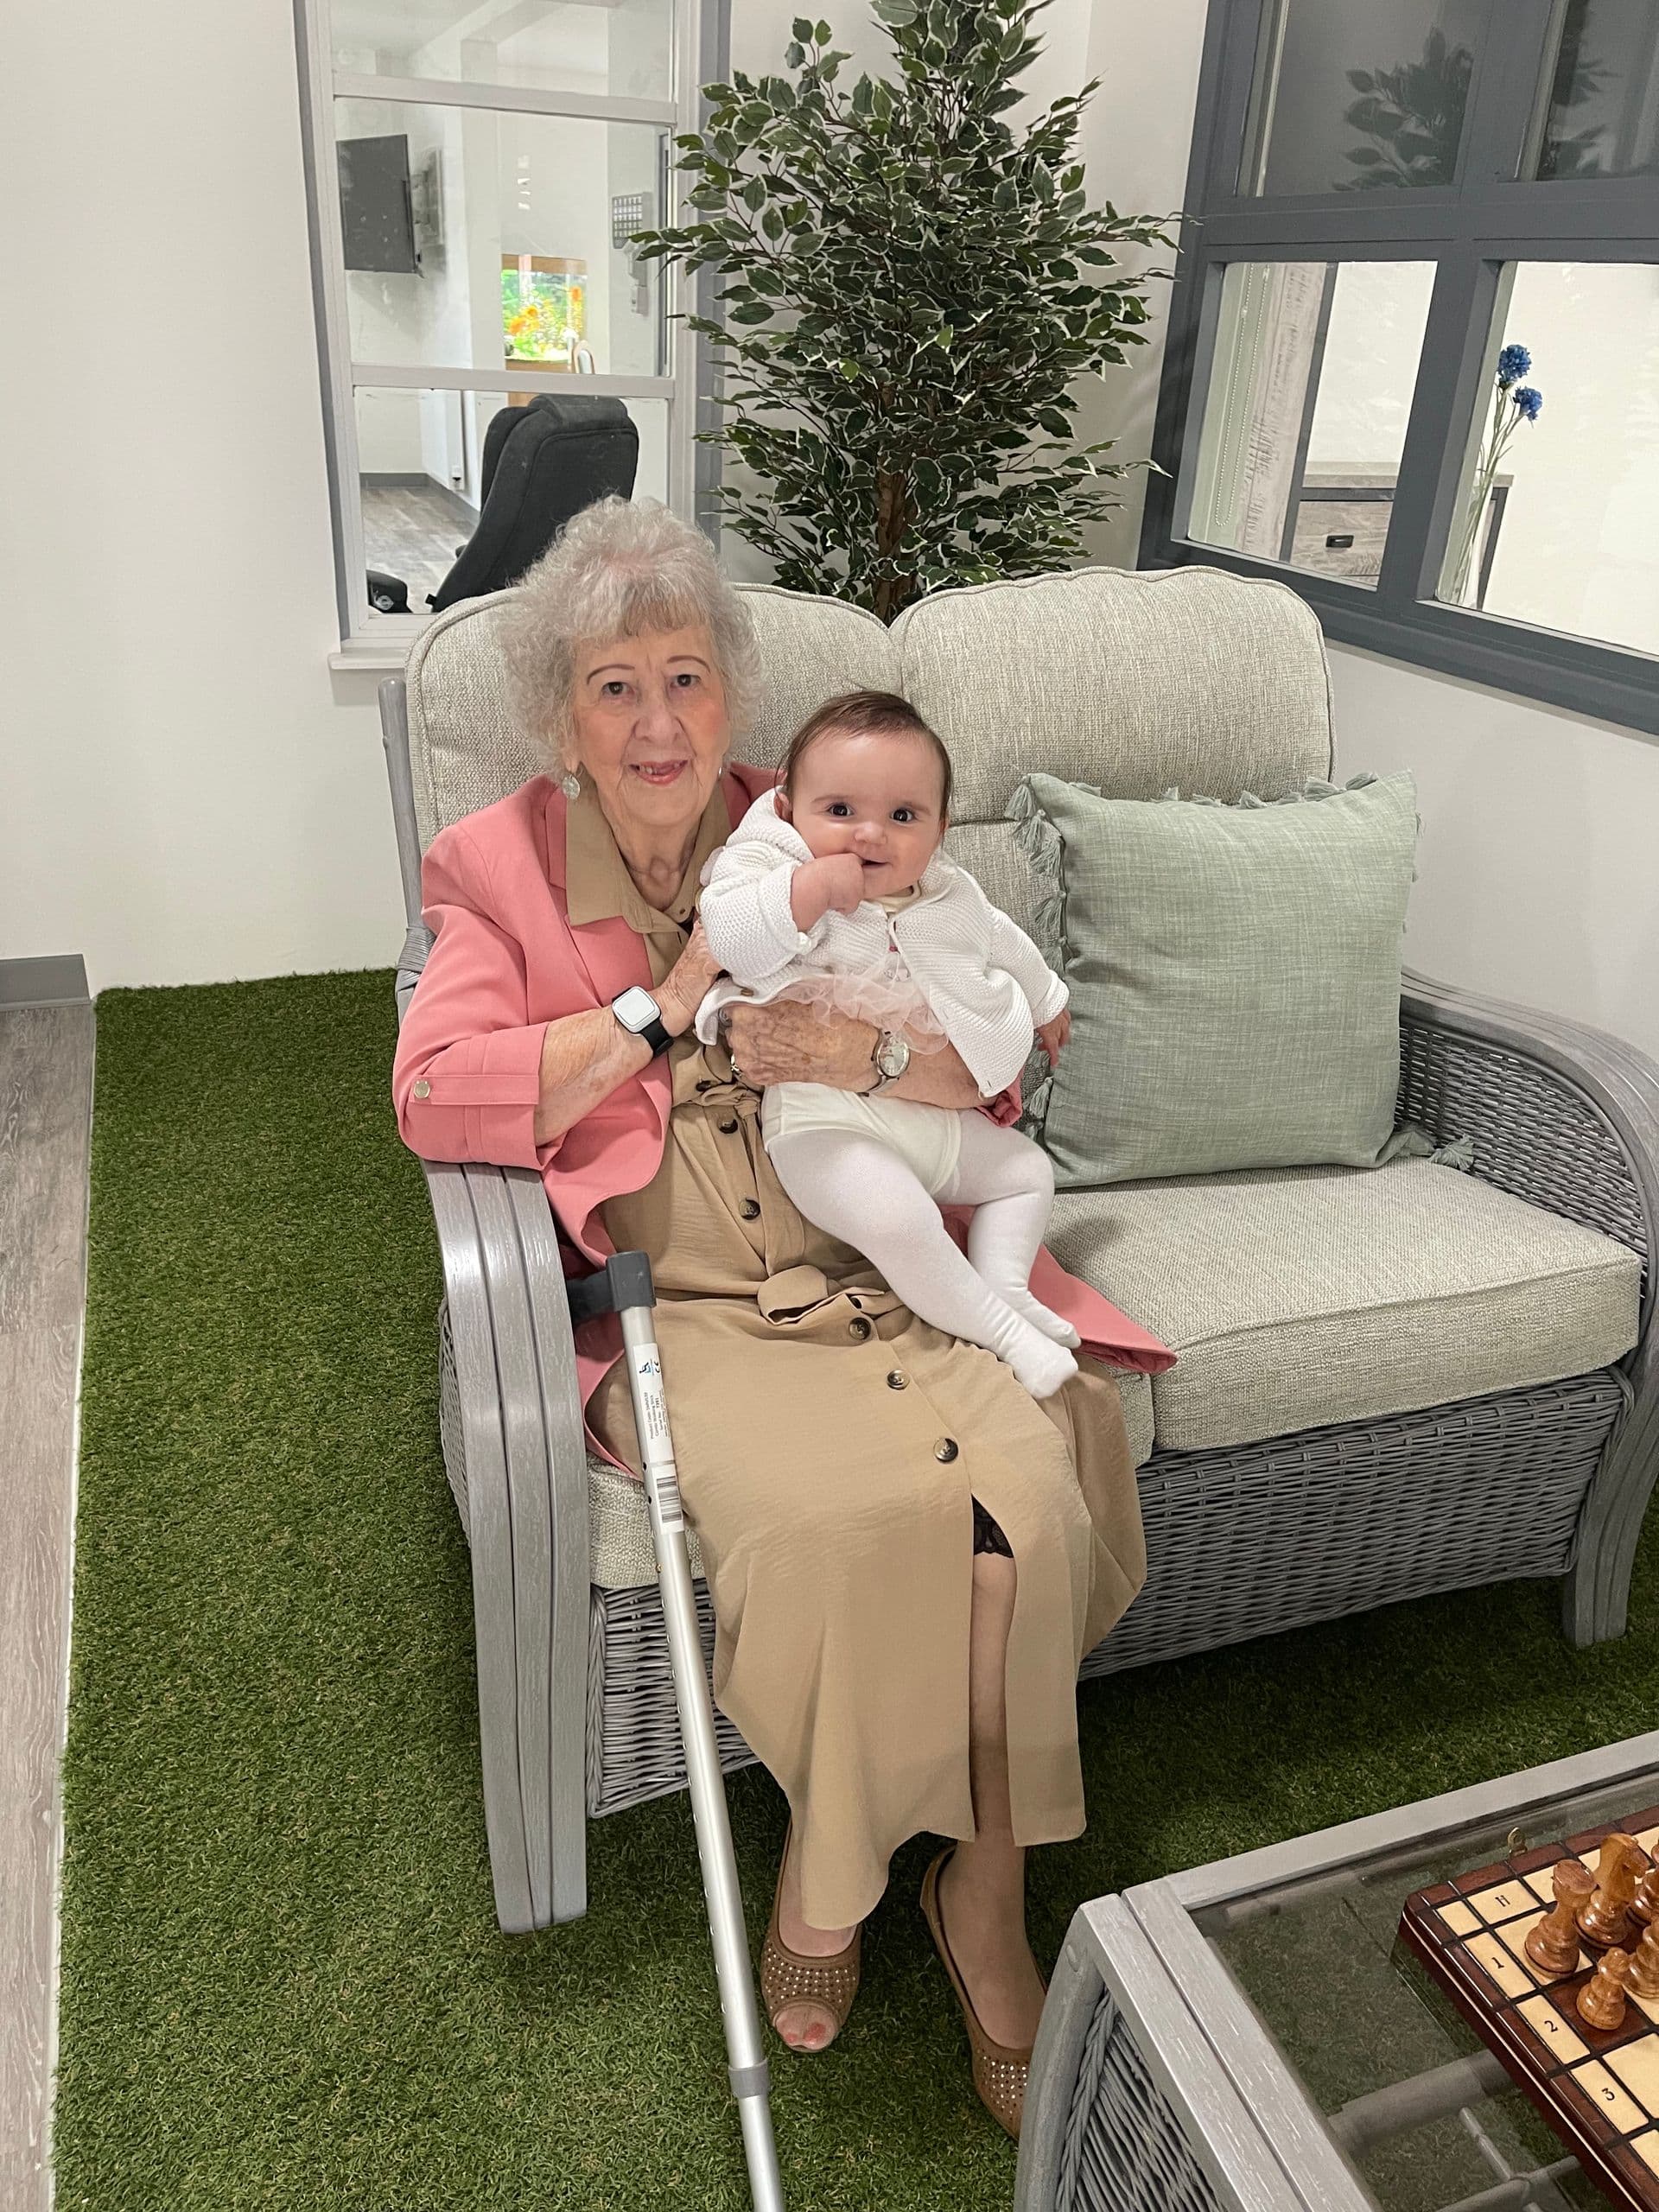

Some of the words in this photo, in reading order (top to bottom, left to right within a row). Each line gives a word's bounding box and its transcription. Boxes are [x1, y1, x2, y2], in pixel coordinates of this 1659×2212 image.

[1495, 1895, 1510, 1907] H
[1491, 1957, 1504, 1969] 1
[1544, 2020, 1559, 2032] 2
[1602, 2088, 1616, 2101] 3
